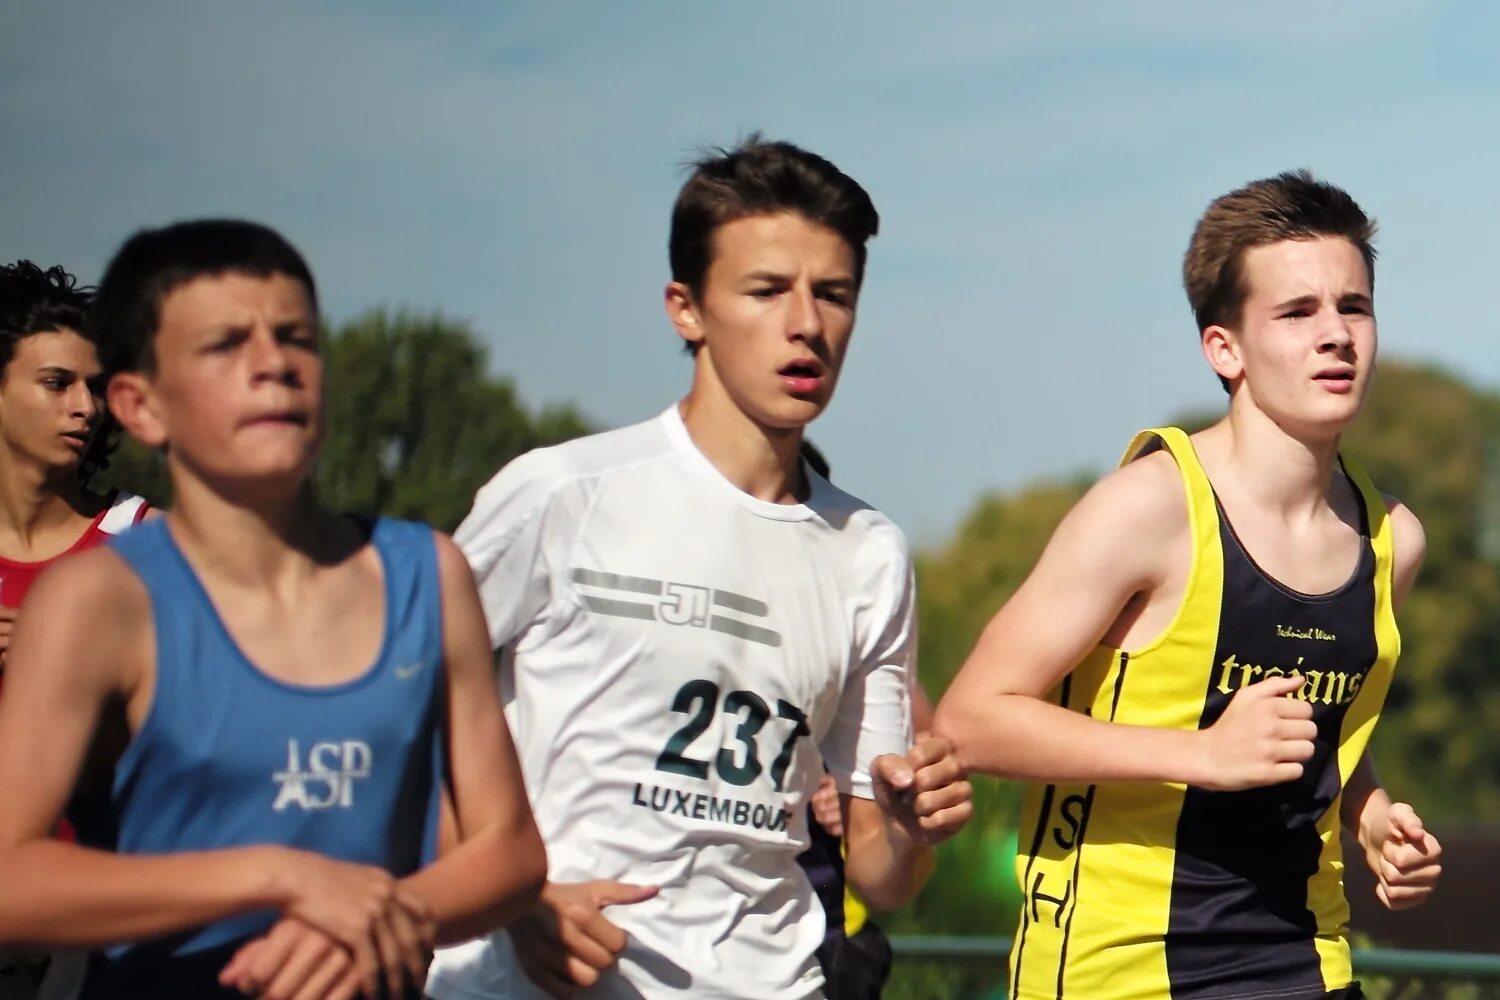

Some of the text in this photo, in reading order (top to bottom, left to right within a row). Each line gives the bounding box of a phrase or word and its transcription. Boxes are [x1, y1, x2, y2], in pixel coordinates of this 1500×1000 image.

[1276, 624, 1337, 641] Technical Wear
[656, 679, 811, 792] 237
